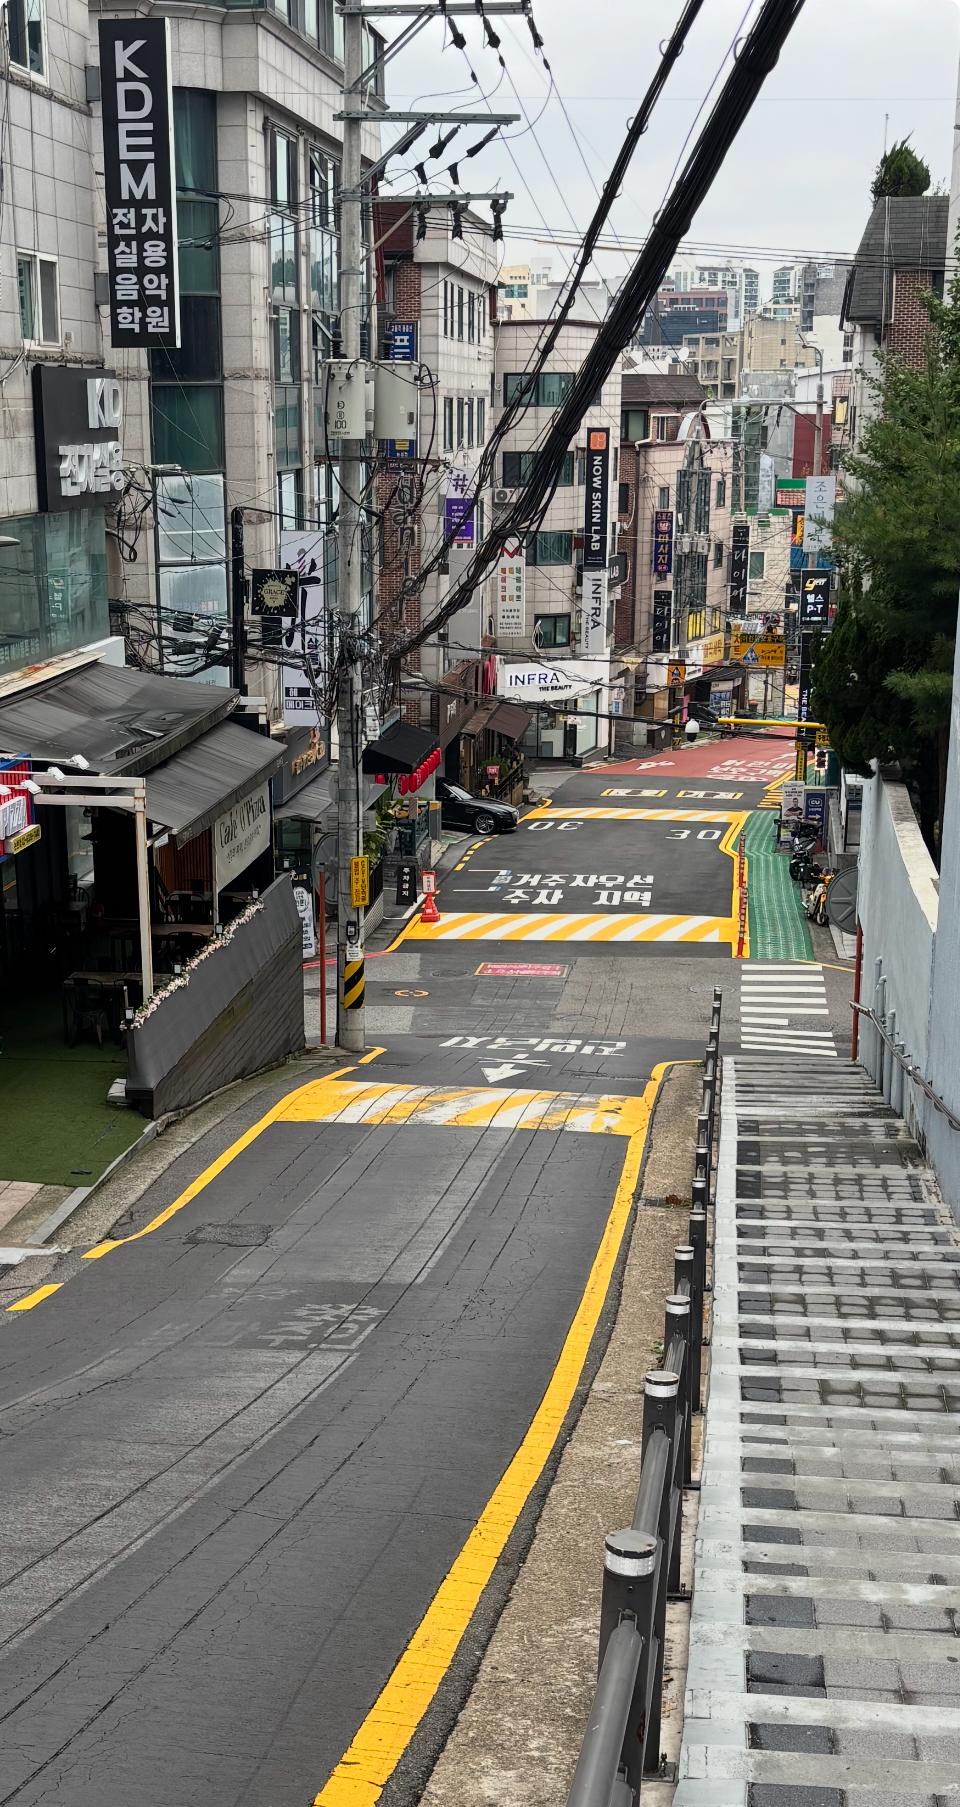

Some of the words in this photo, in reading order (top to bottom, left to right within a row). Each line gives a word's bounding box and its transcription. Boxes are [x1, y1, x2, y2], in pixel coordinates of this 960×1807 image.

[114, 39, 155, 200] KDEM
[112, 207, 166, 234] 전자
[113, 240, 166, 268] 실용
[114, 273, 169, 301] 음악
[116, 306, 170, 334] 학원
[592, 455, 603, 488] NOW
[591, 491, 602, 521] SKIN
[590, 523, 601, 552] LAB
[591, 578, 602, 630] INFRA
[806, 593, 825, 603] 헬스
[509, 672, 560, 687] INFRA
[527, 821, 584, 831] 30
[664, 829, 723, 840] 30
[511, 873, 655, 888] 거주자우선
[591, 890, 653, 907] 지역
[438, 1036, 628, 1057] 진입금지
